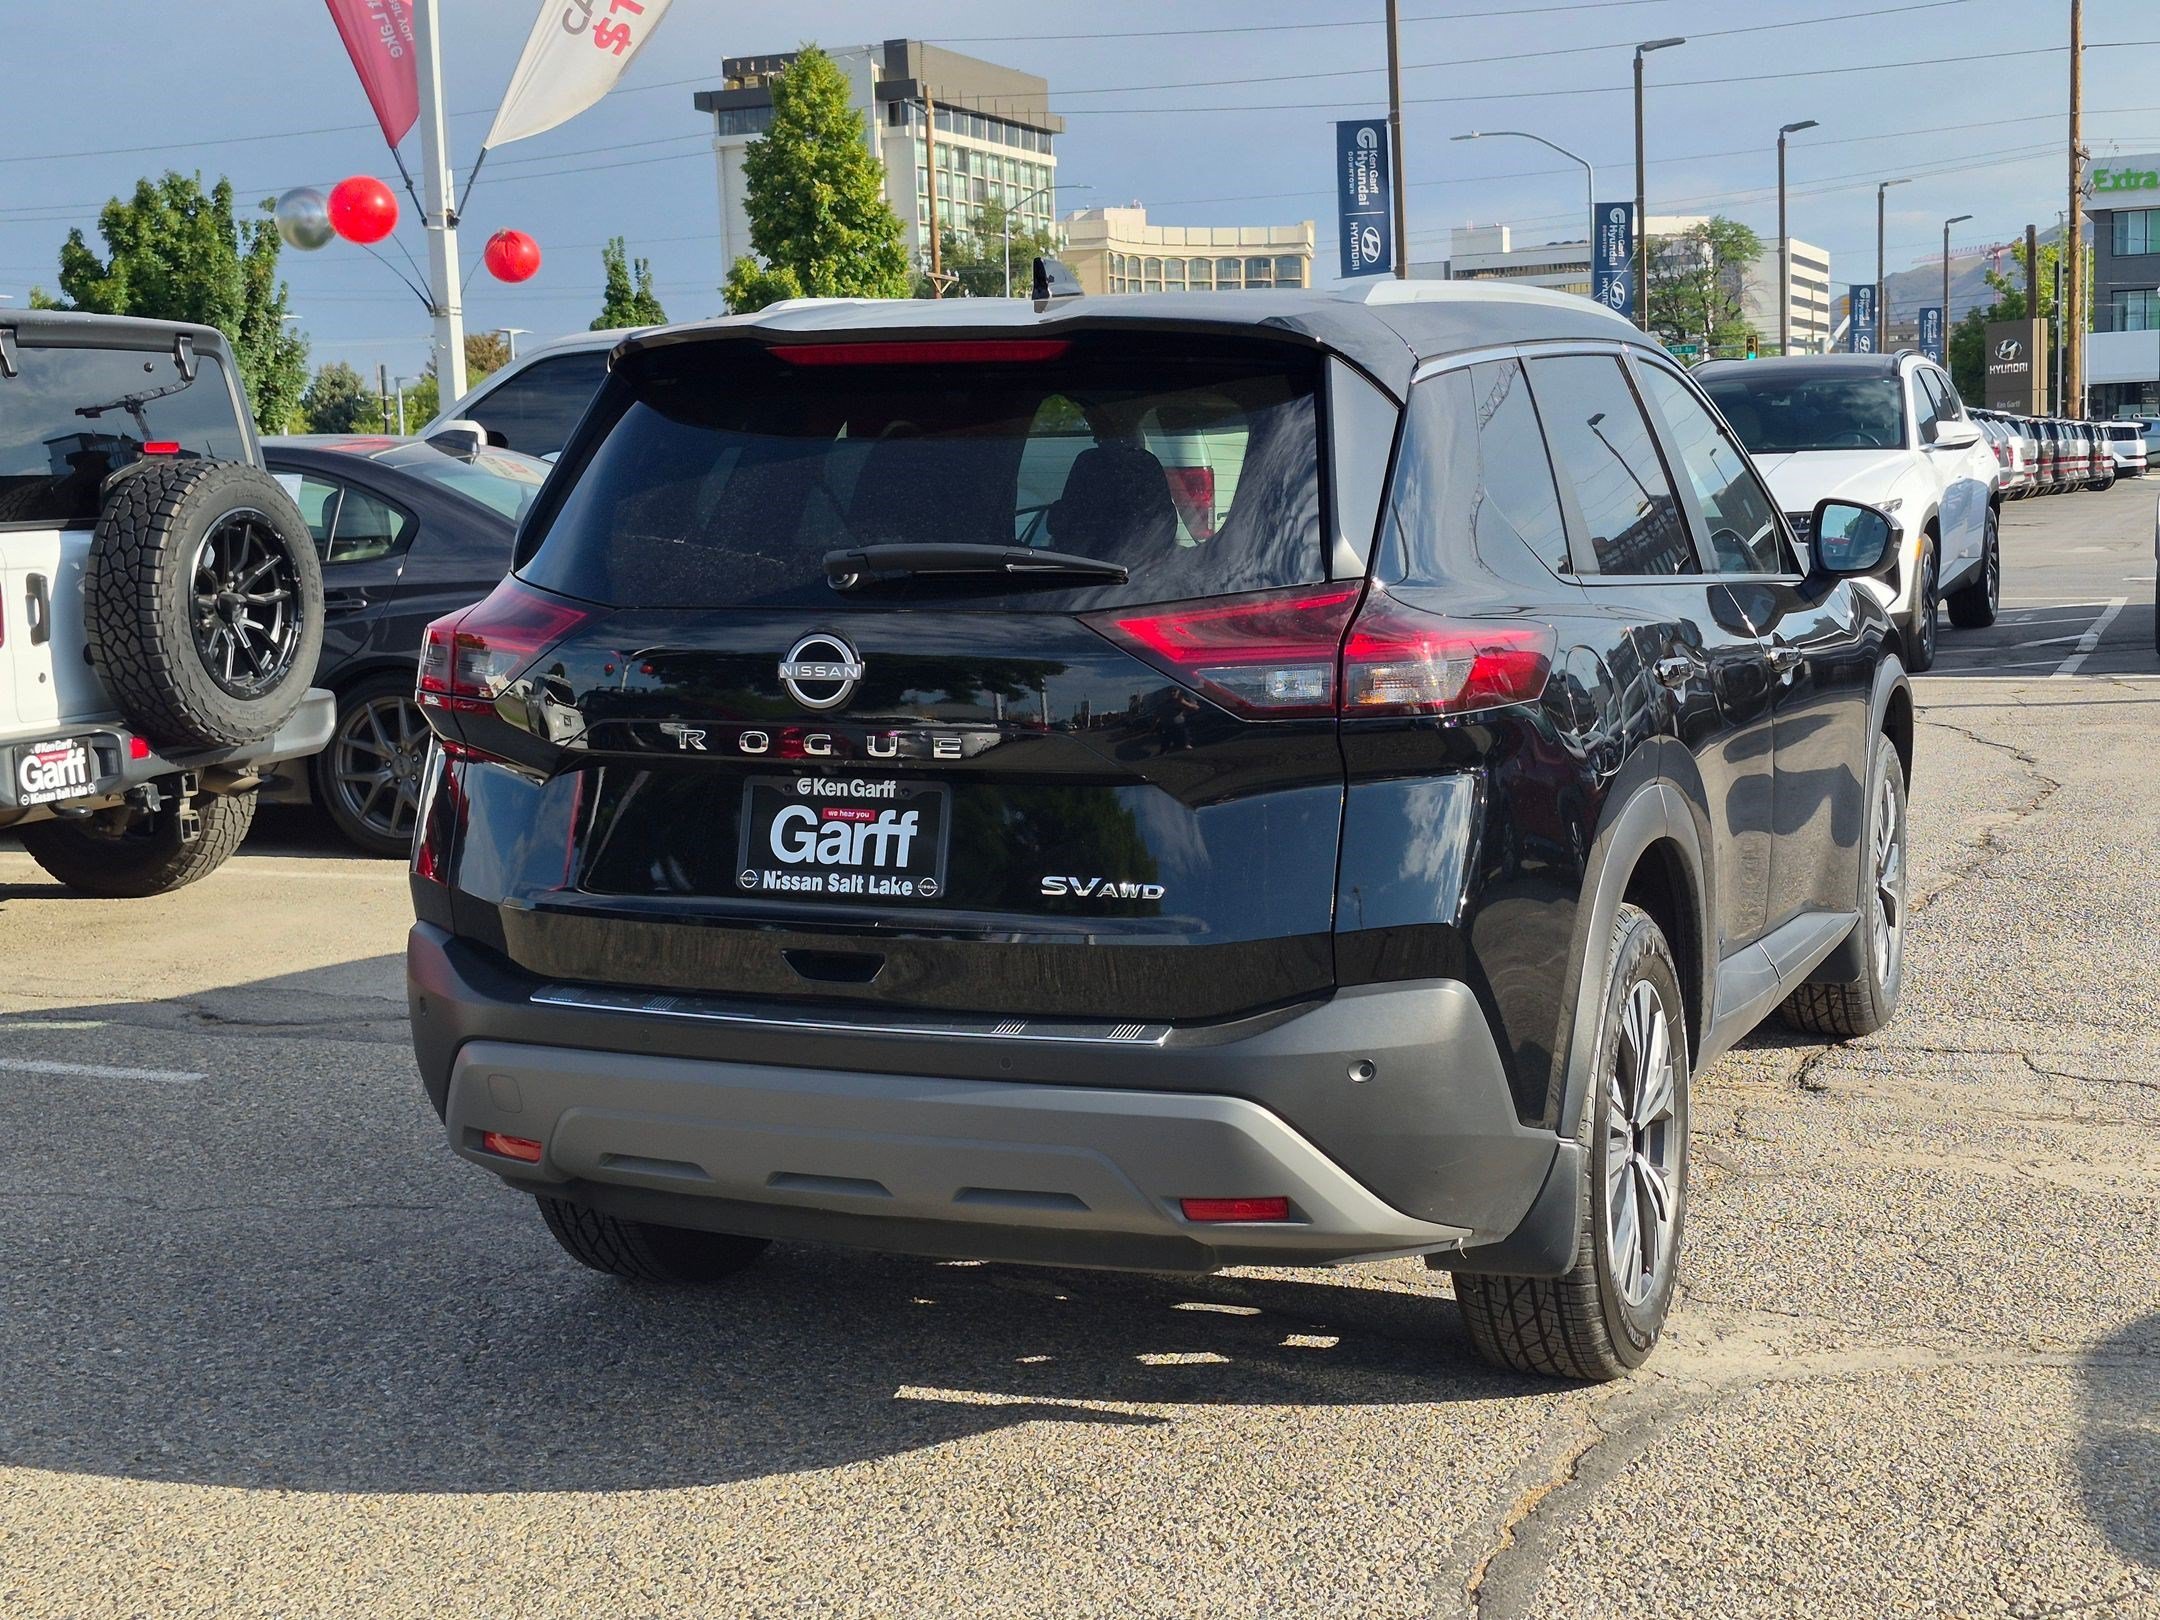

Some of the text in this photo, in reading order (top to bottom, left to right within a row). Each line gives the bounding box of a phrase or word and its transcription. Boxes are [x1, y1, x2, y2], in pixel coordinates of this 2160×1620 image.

[1355, 150, 1369, 206] Hyundai
[1369, 150, 1379, 194] Ken Garff
[2093, 168, 2158, 192] Extra
[1350, 222, 1360, 270] HYUNDAI
[1608, 225, 1618, 266] Hyundai
[1989, 362, 2028, 375] HYUNDAI
[780, 666, 858, 678] NISSAN
[678, 729, 962, 759] ROGUE
[20, 747, 86, 793] Garff
[813, 778, 897, 798] Ken Garff
[856, 811, 870, 819] you
[770, 804, 919, 868] Garff
[763, 870, 913, 896] Nissan Salt Lake
